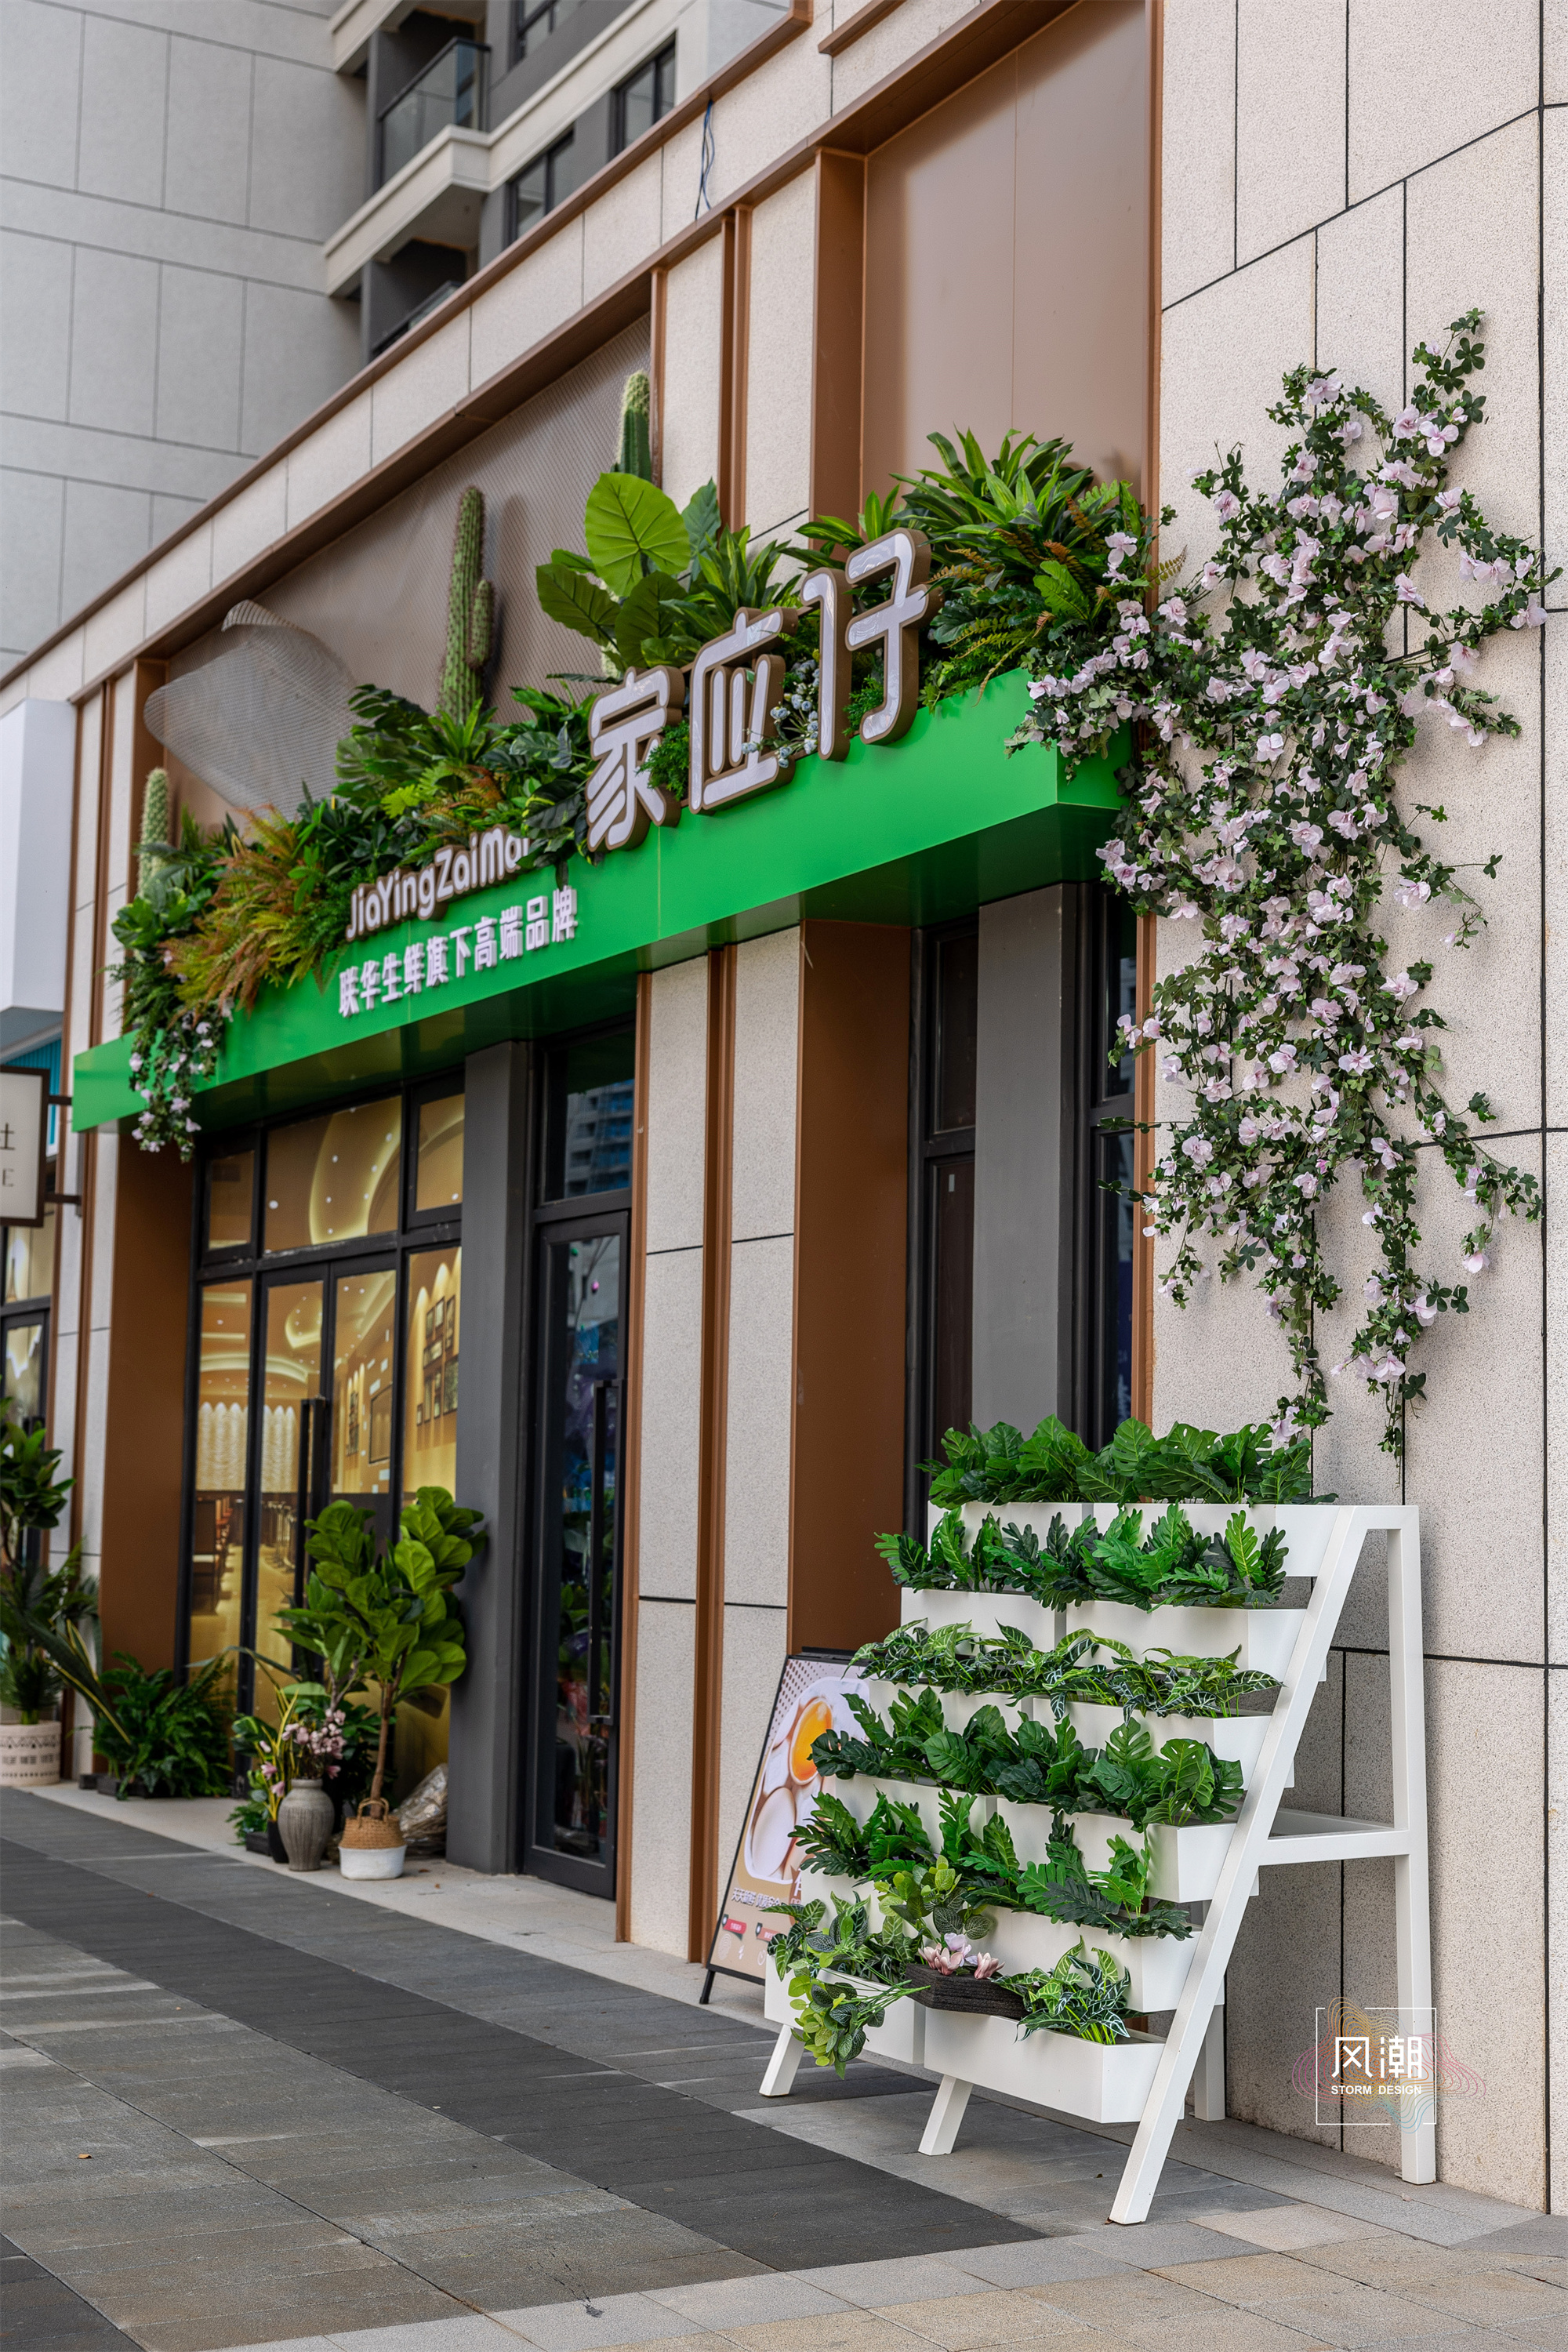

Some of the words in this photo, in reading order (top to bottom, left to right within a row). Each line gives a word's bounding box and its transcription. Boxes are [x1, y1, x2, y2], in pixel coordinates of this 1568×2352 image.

[339, 886, 578, 1018] 联华生鲜旗下高端品牌
